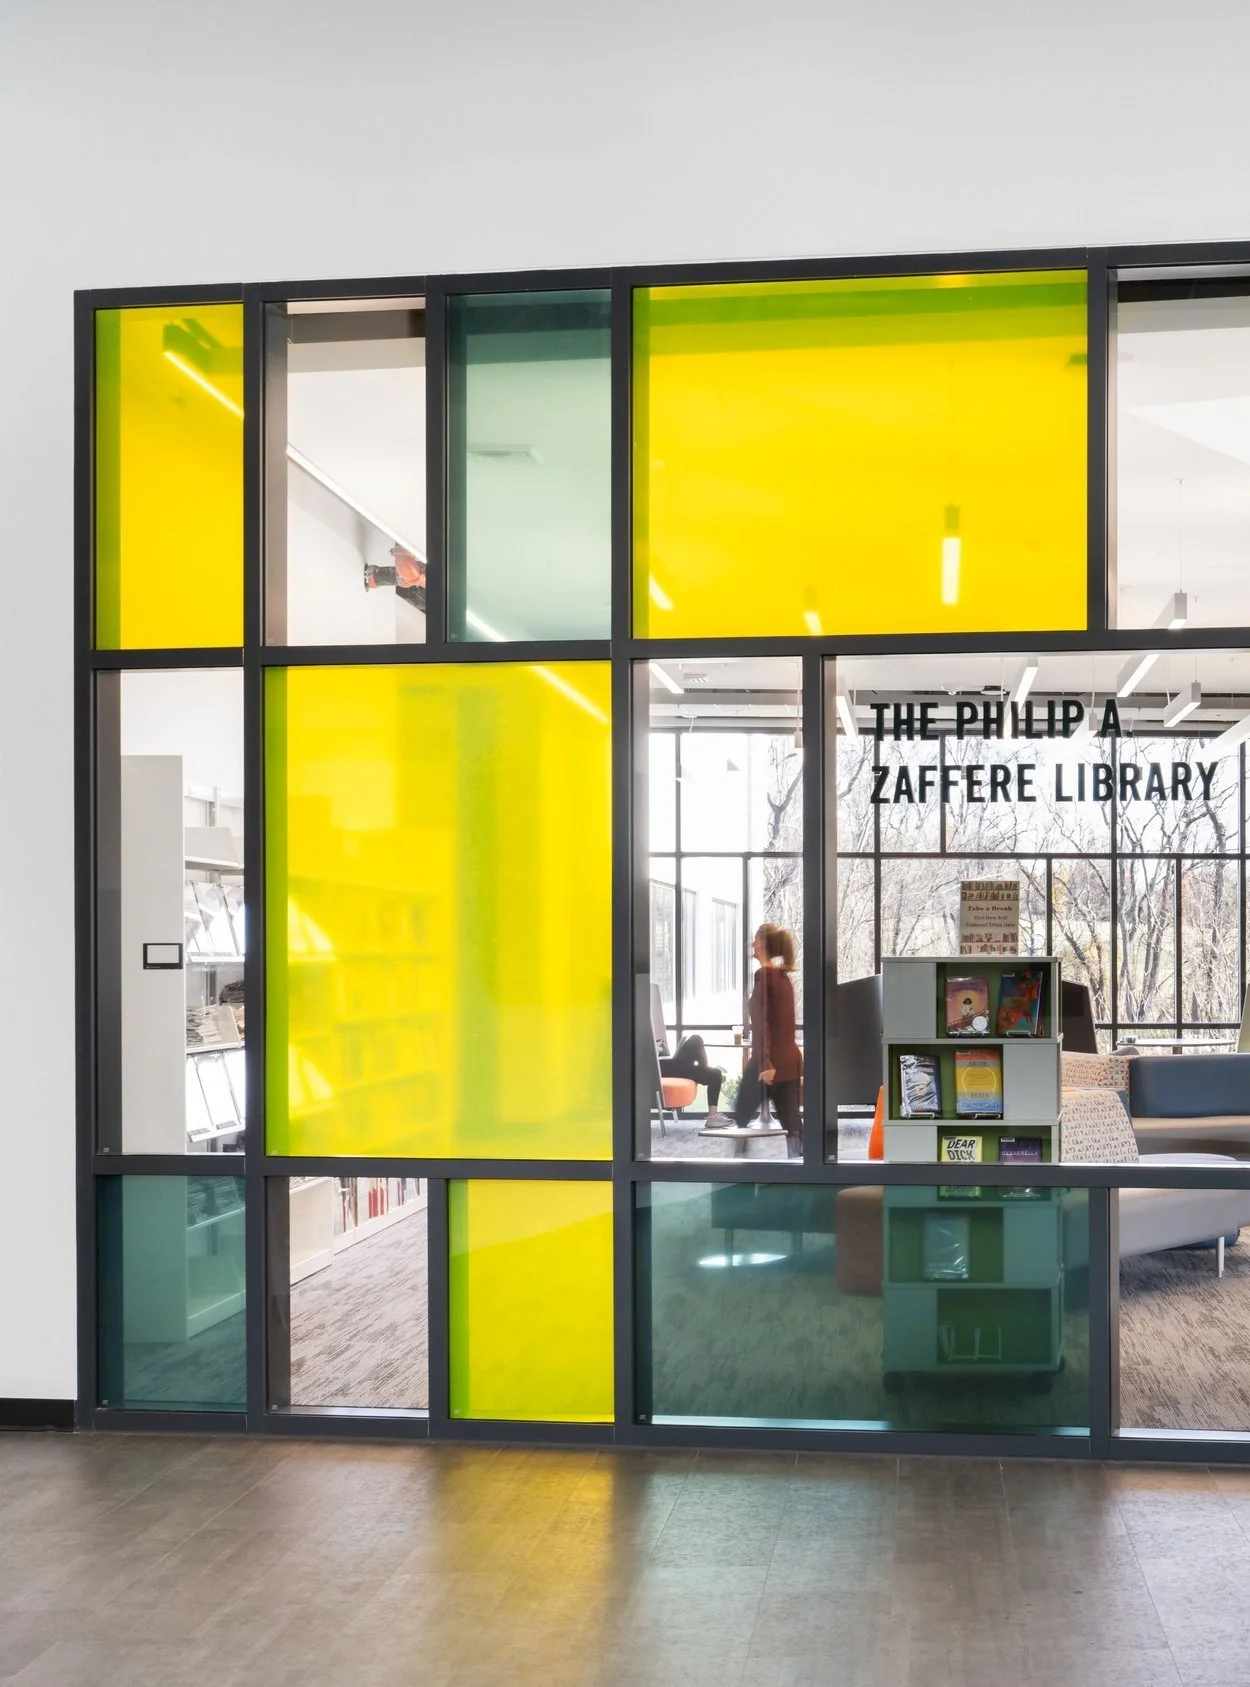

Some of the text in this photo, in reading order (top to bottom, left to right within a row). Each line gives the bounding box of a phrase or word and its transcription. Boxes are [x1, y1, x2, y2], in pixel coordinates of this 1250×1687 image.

[870, 699, 1122, 741] THE PHILIP A
[871, 761, 1219, 804] ZAFFERE LIBRARY
[947, 1139, 976, 1149] DEAR
[947, 1150, 975, 1160] DICK
